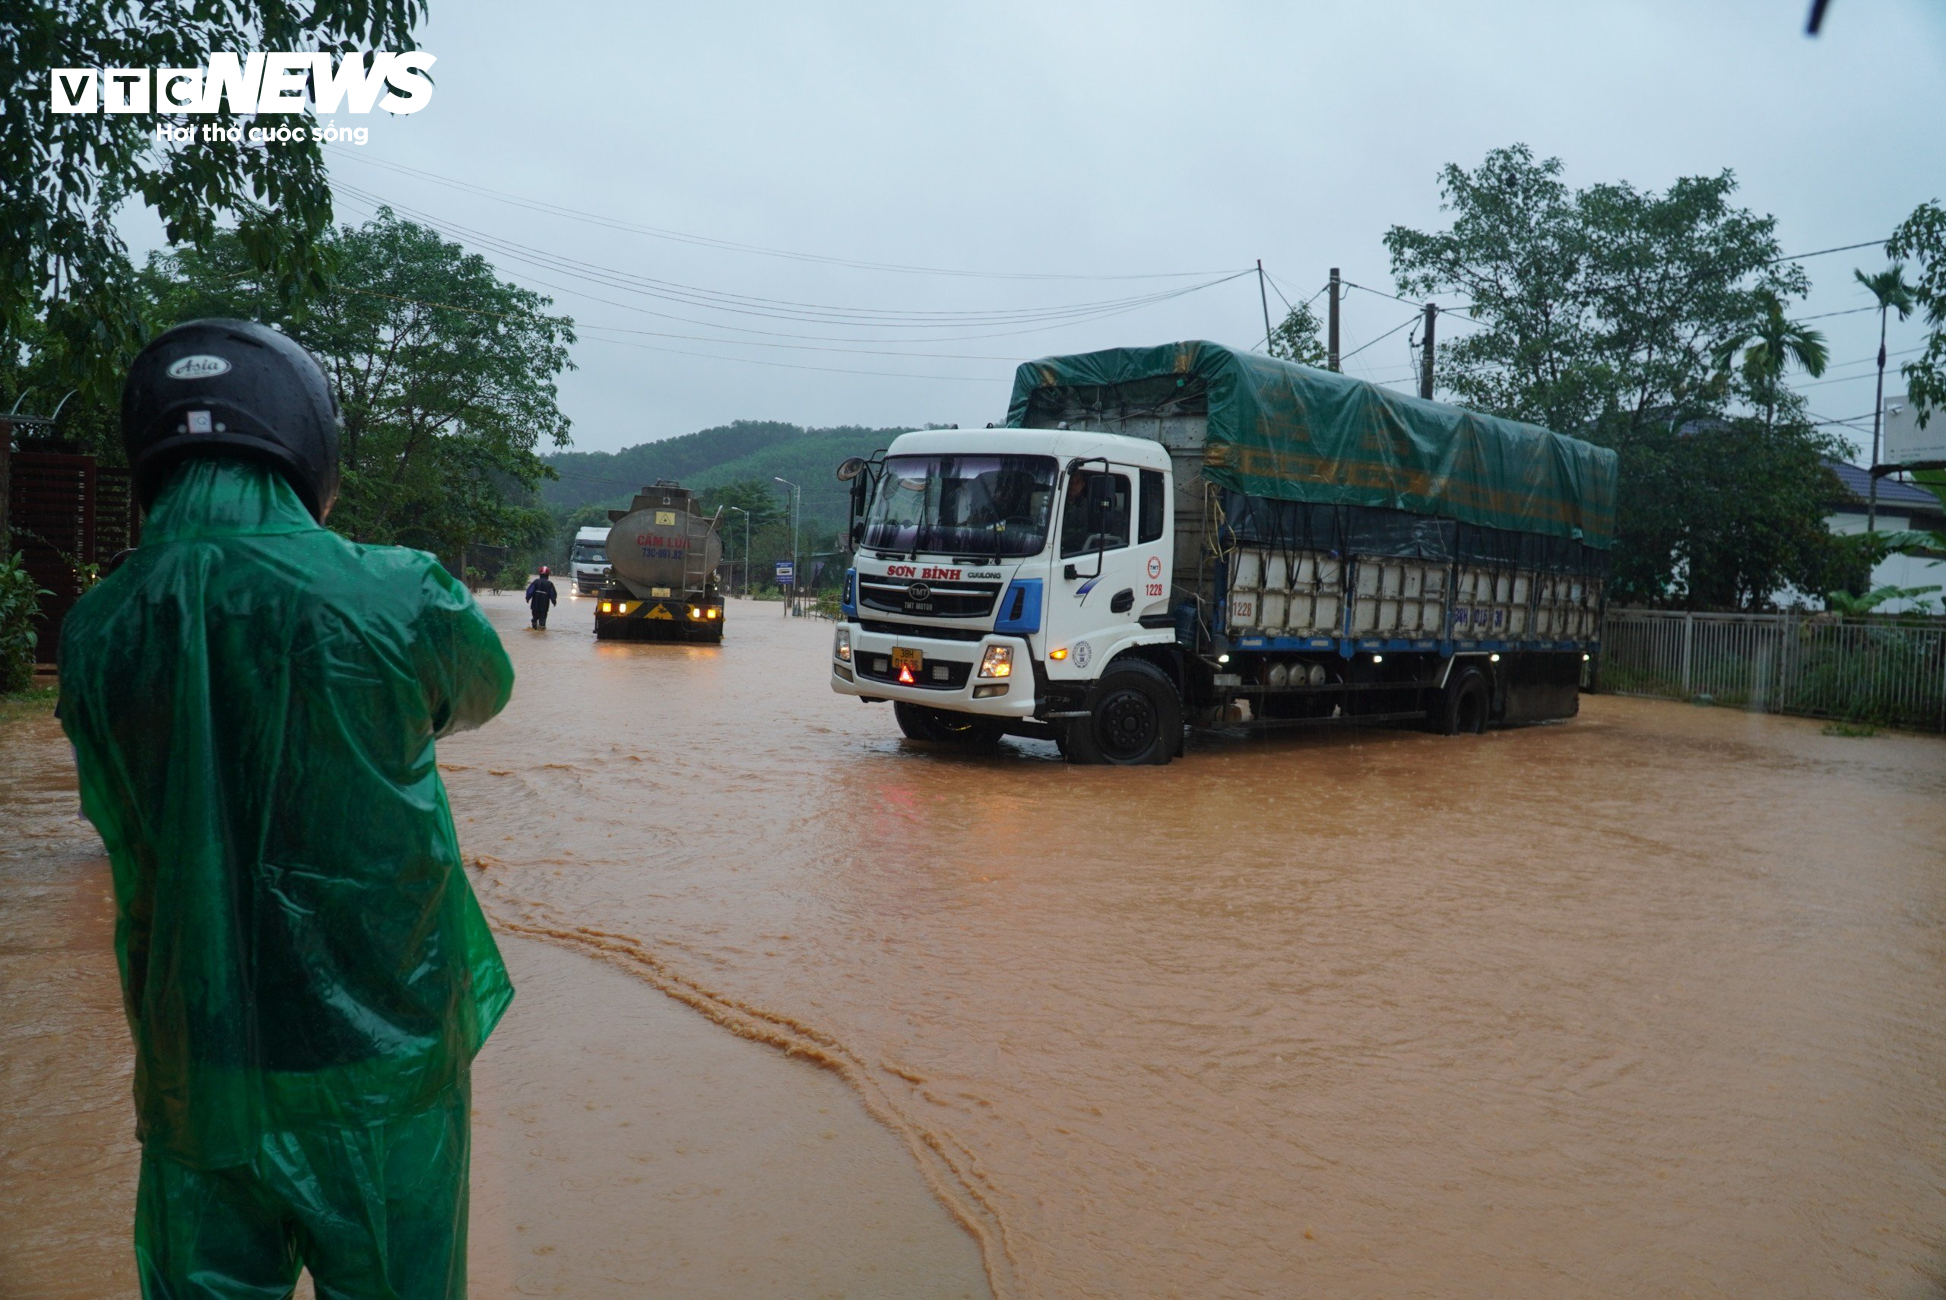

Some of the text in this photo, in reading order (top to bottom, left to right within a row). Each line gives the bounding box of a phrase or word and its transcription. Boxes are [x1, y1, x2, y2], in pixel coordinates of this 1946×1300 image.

[176, 359, 219, 374] Asia
[637, 531, 663, 547] CẤM
[887, 565, 916, 578] SƠN
[911, 587, 928, 596] TMT
[1145, 583, 1163, 596] 1228
[904, 601, 933, 611] TMT MOTOR
[1232, 602, 1253, 617] 1228
